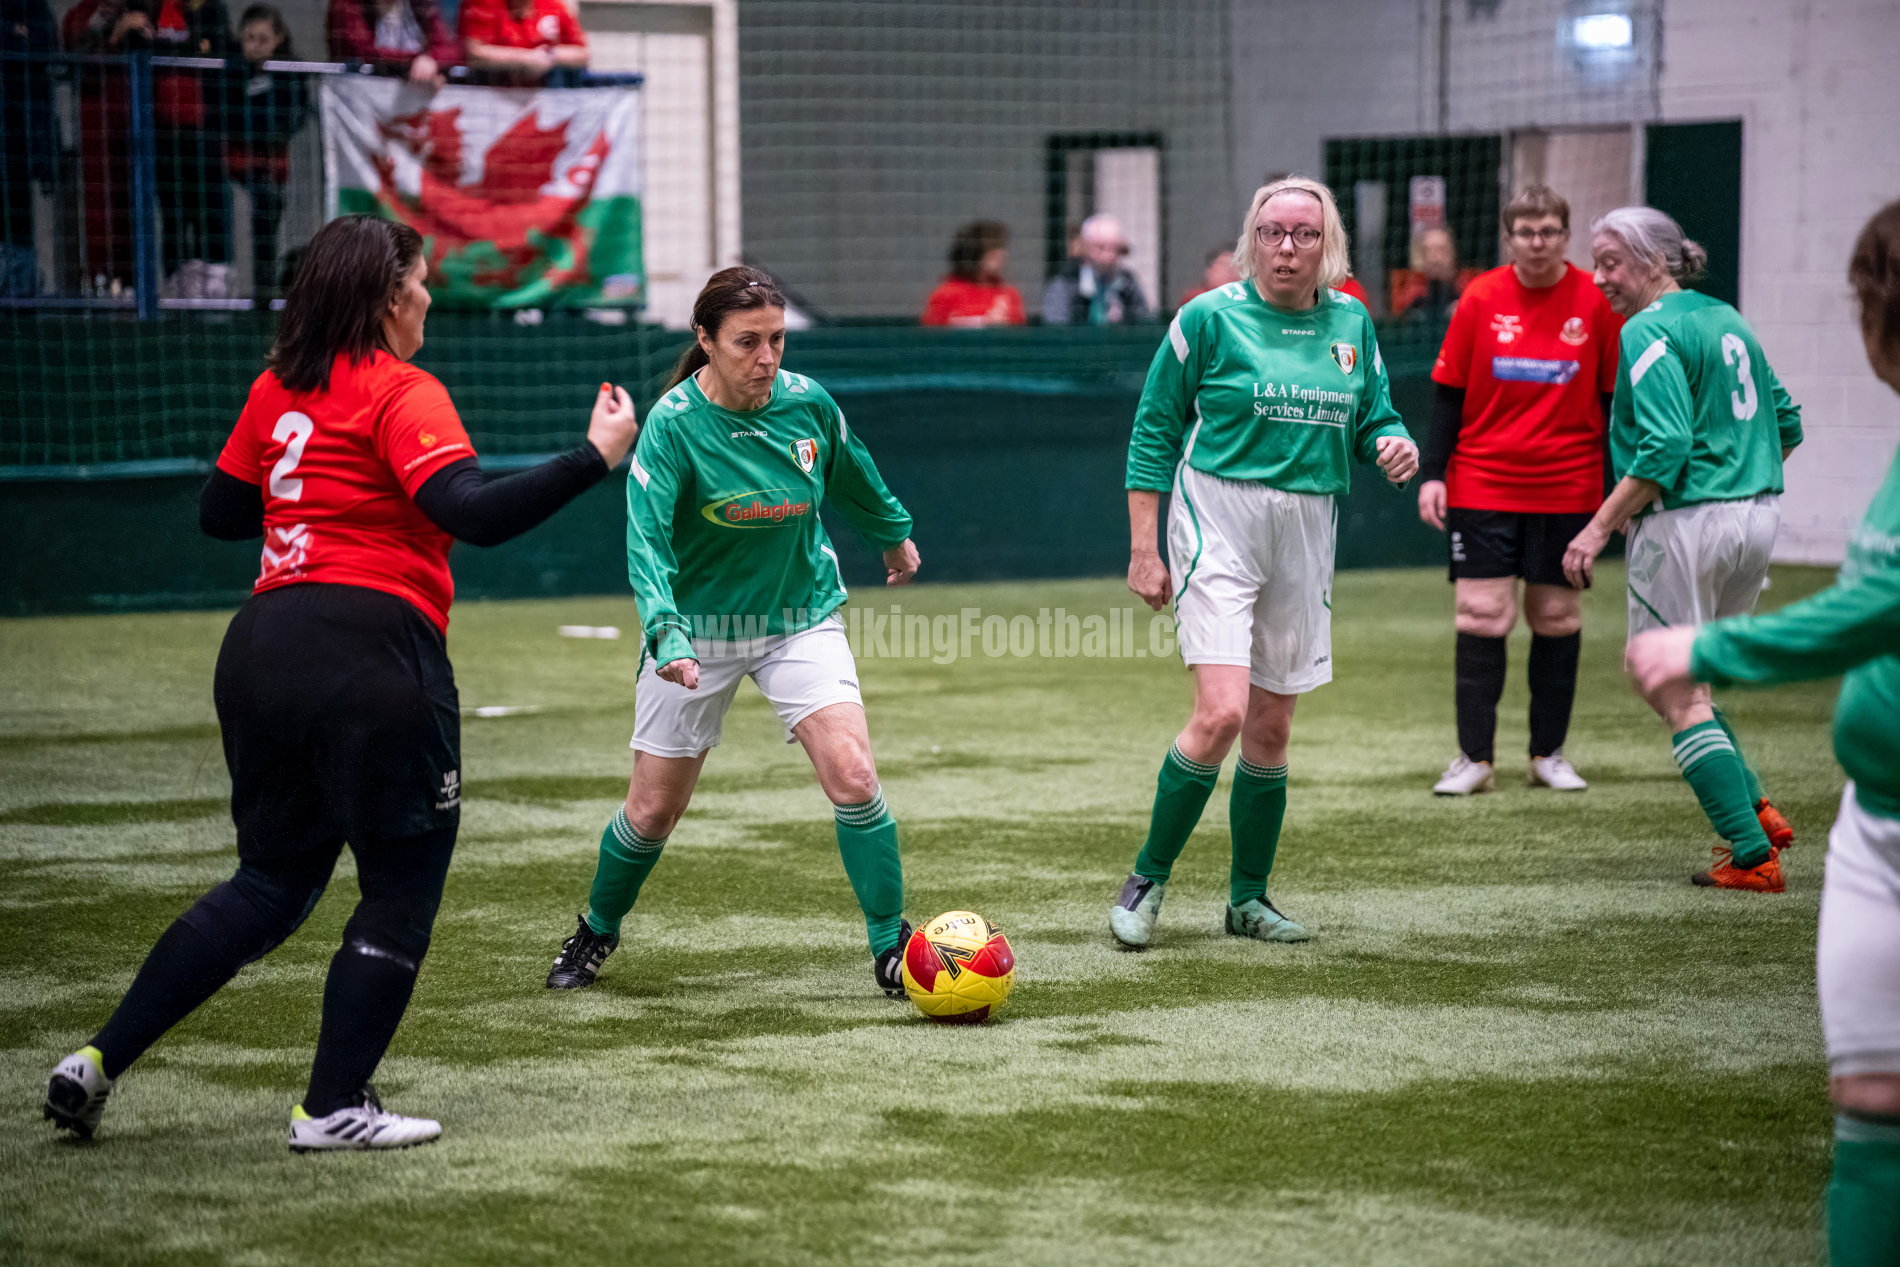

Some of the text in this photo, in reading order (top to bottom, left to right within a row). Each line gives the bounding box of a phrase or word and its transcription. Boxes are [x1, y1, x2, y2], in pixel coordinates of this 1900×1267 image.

[1281, 328, 1316, 336] STANNO
[1721, 332, 1758, 421] 3
[1253, 382, 1353, 405] L&A Equipment
[1253, 401, 1350, 423] Services Limited
[731, 430, 768, 438] STANNO
[269, 411, 314, 502] 2
[725, 498, 810, 522] Gallagher
[933, 917, 976, 935] mitre
